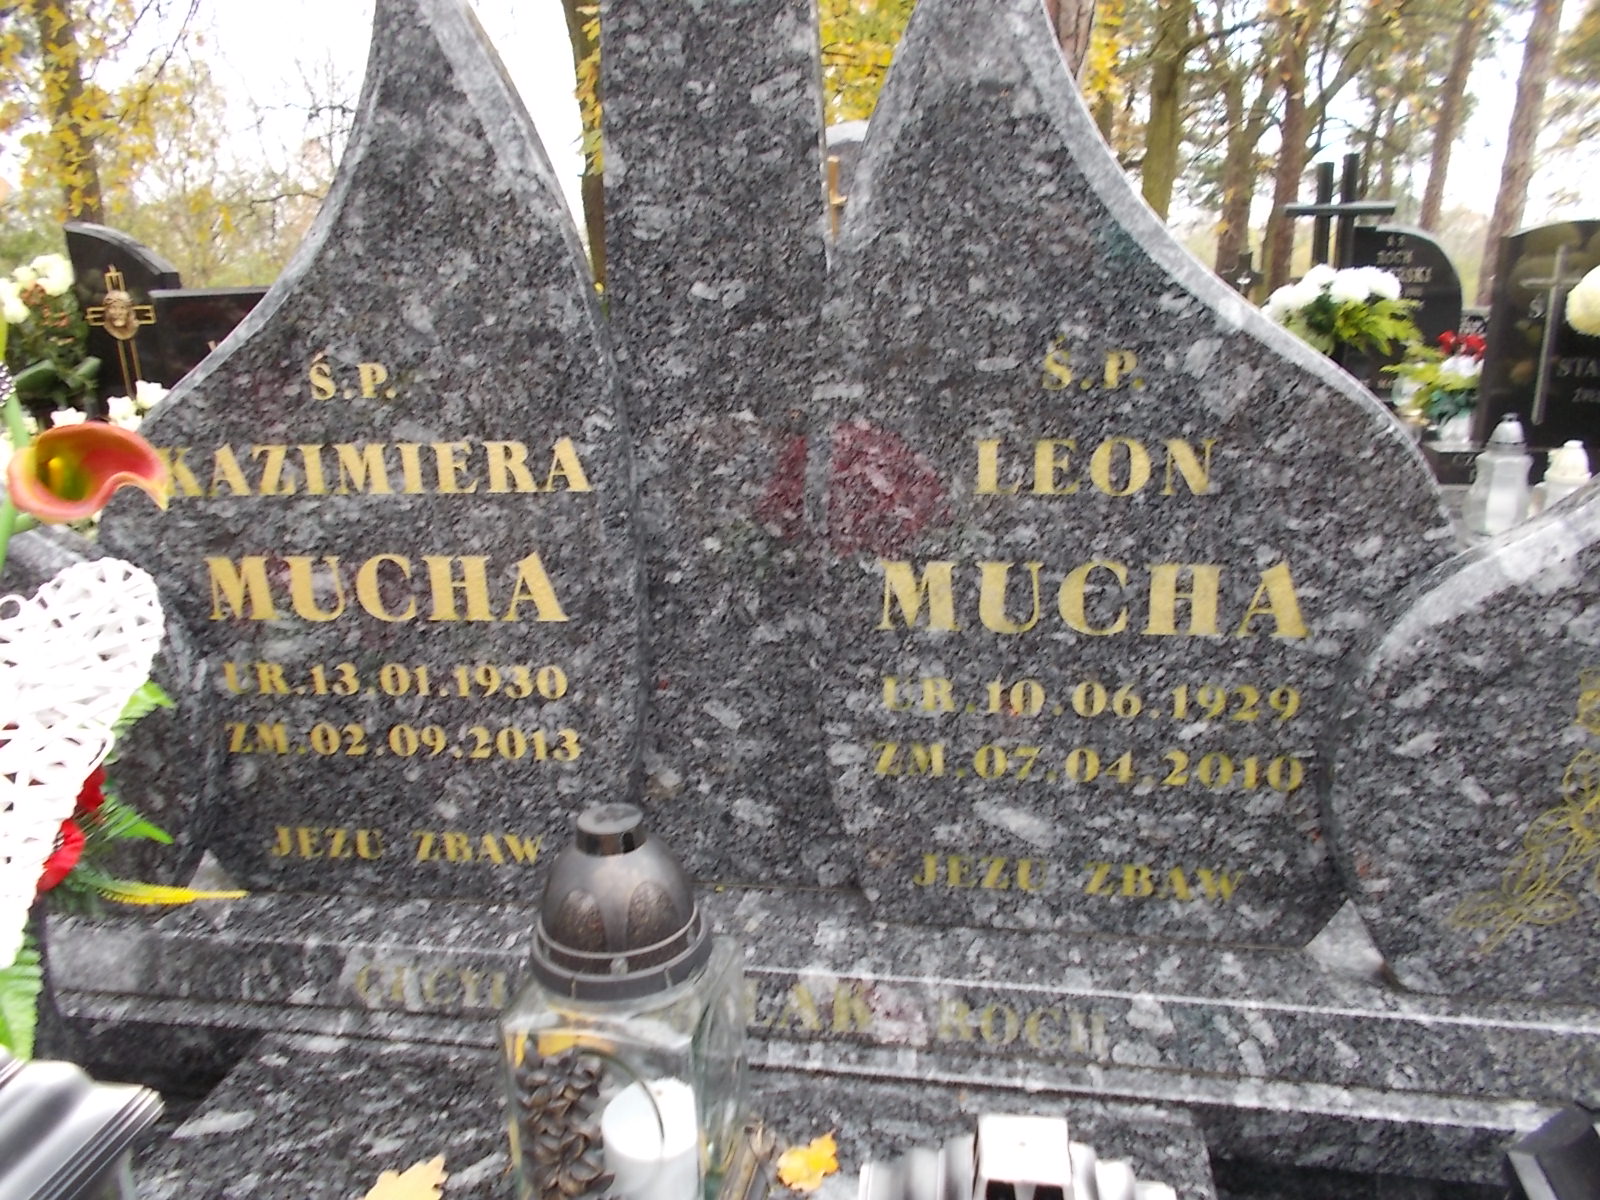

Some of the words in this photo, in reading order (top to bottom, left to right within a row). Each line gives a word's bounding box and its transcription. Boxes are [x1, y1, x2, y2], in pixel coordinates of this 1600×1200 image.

[308, 350, 397, 400] Ś.P.
[1042, 335, 1145, 391] Ś.P.
[156, 436, 593, 497] KAZIMIERA
[973, 436, 1217, 497] LEON
[204, 551, 570, 623] MUCHA
[874, 559, 1310, 639] MUCHA
[222, 661, 569, 700] UR.13.01.1930
[880, 674, 1301, 722] UR.10.06.1929
[224, 721, 583, 762] ZM.02.09.2013
[872, 741, 1304, 792] ZM.07.04.2010
[271, 825, 384, 860] JEZU
[411, 829, 544, 865] ZBAW
[912, 853, 1047, 892] JEZU
[1083, 861, 1245, 902] ZBAW
